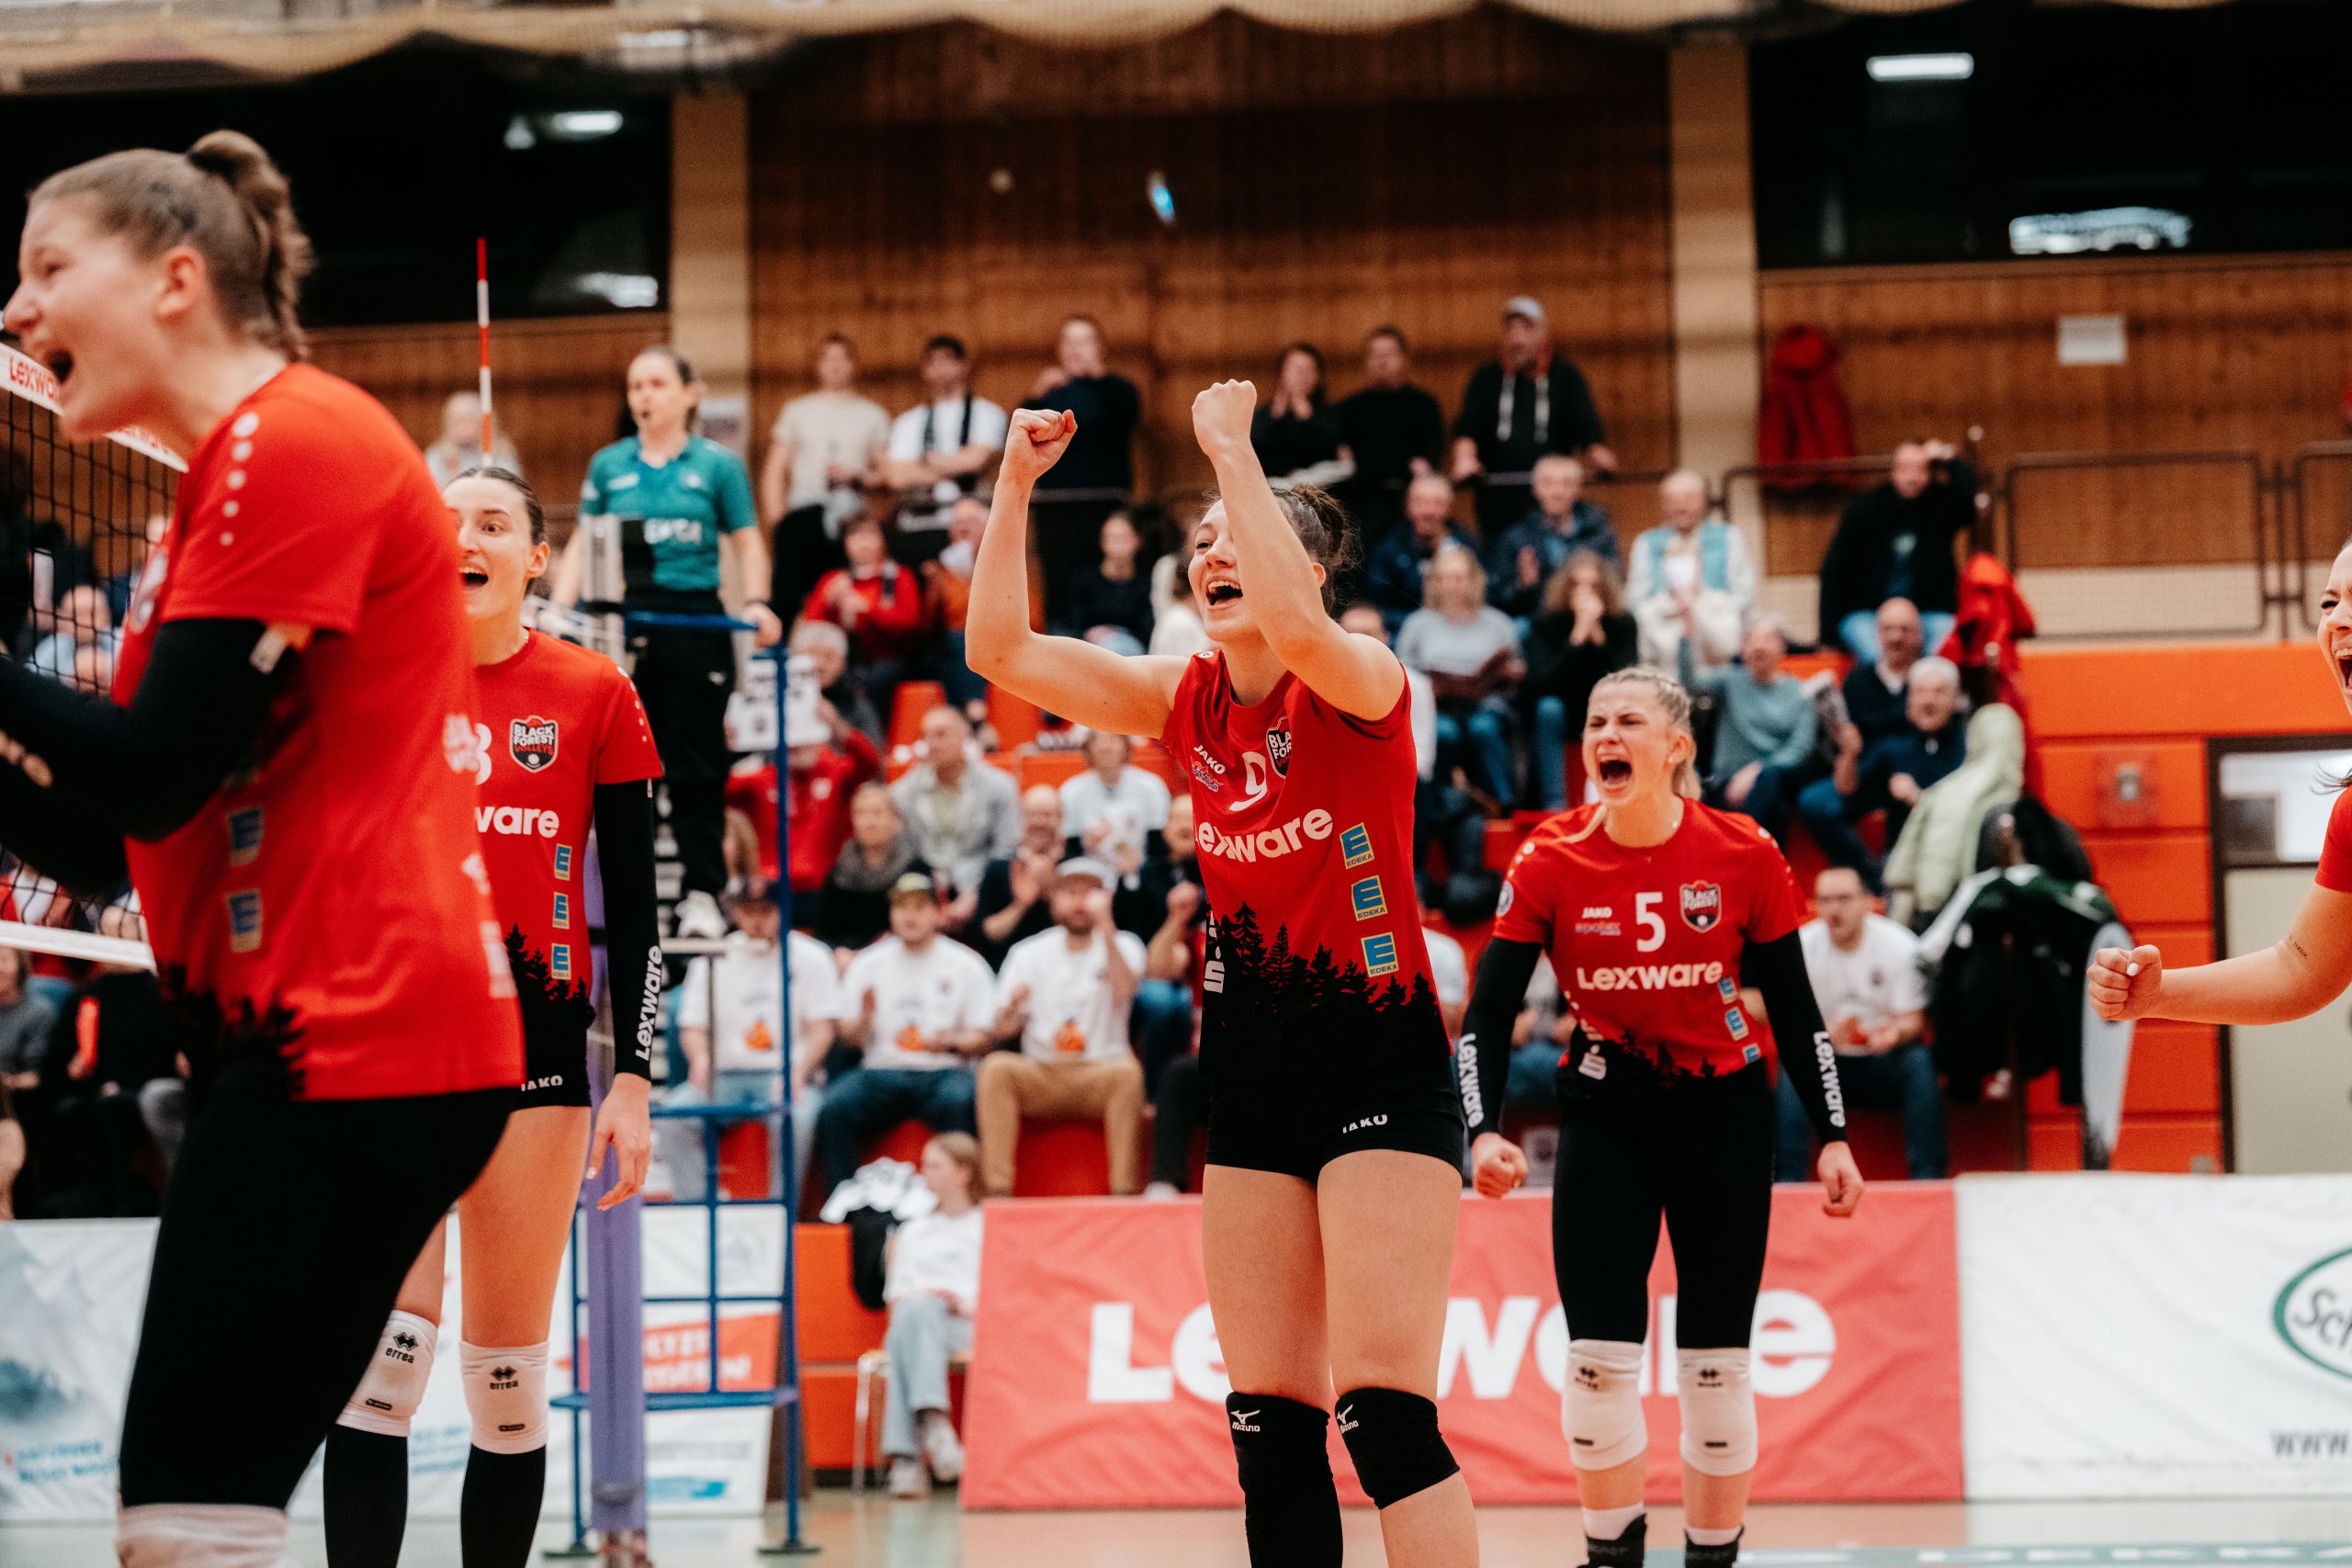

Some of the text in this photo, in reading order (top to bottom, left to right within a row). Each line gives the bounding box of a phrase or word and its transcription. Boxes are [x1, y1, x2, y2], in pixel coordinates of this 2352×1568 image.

[514, 724, 554, 738] BLACK
[514, 735, 554, 746] FOREST
[1269, 731, 1291, 749] BLA
[1193, 745, 1226, 774] JAKO
[1229, 750, 1268, 811] 9
[1196, 808, 1333, 863] exware
[1346, 852, 1374, 868] EDEKA
[1357, 907, 1385, 919] EDEKA
[1582, 907, 1612, 919] JAKO
[1635, 892, 1666, 953] 5
[1370, 963, 1397, 975] EDEKA
[1577, 961, 1723, 991] Lexware
[635, 945, 662, 1061] Lexware
[1457, 1032, 1484, 1128] Lexware
[1813, 1031, 1846, 1128] Lexware
